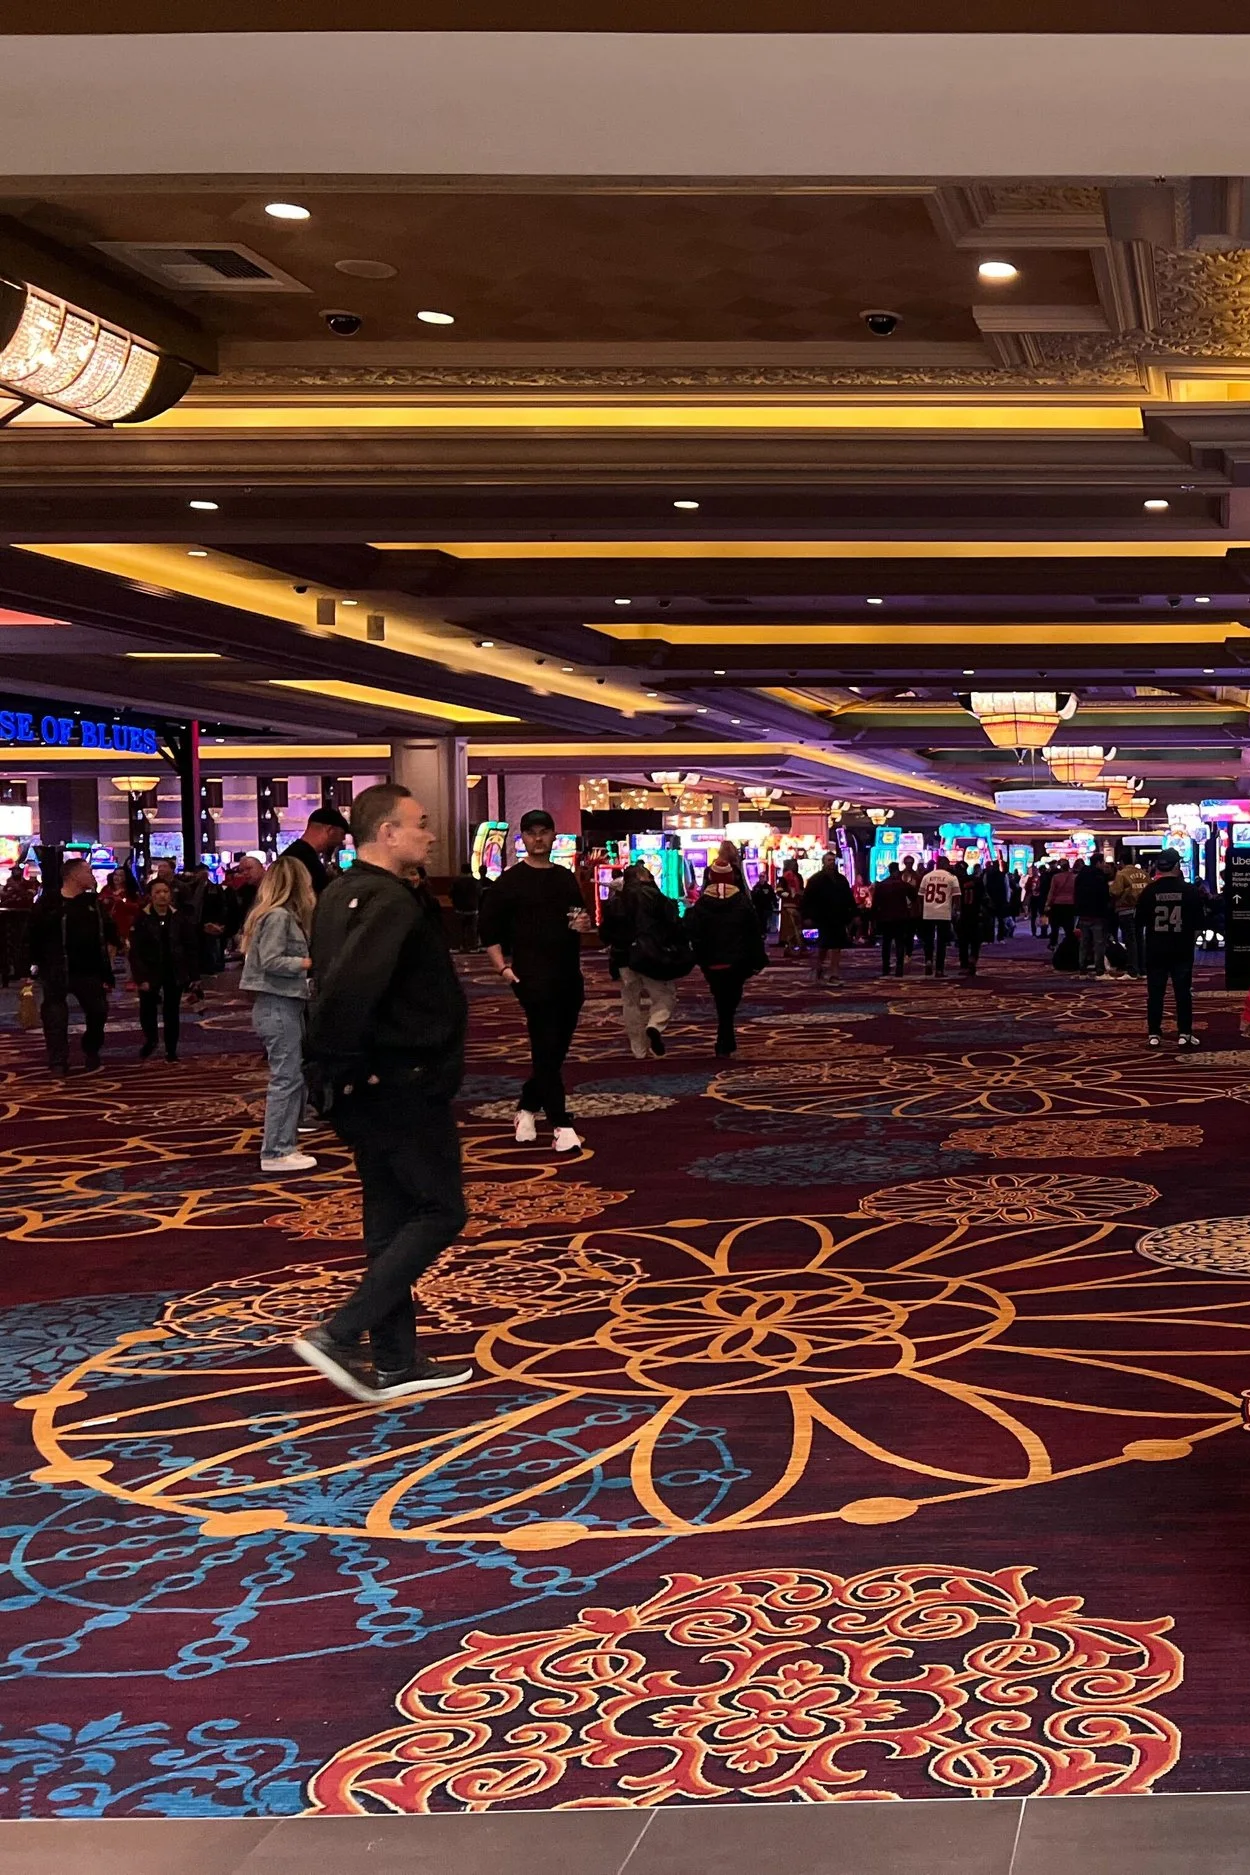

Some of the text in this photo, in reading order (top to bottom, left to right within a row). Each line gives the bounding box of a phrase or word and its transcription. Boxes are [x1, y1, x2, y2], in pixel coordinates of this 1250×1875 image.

[41, 715, 74, 744] OF
[80, 720, 157, 754] BLUES
[925, 883, 948, 904] 85
[1154, 905, 1182, 932] 24
